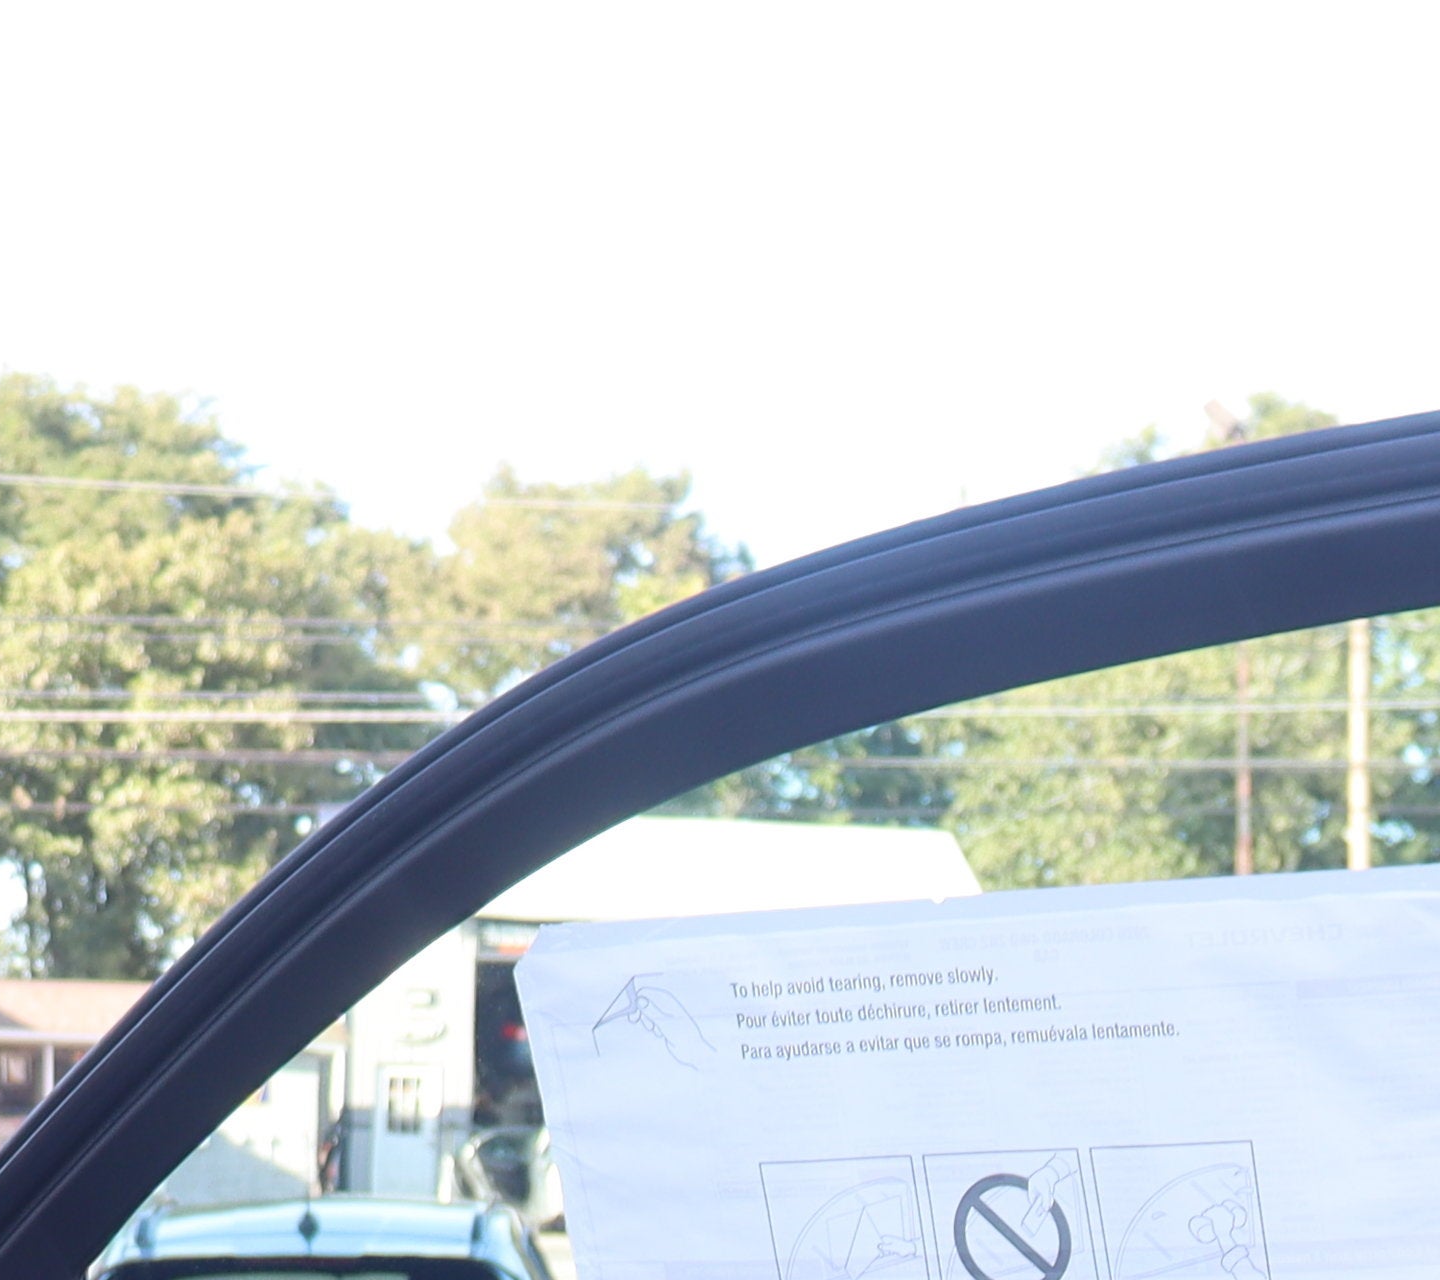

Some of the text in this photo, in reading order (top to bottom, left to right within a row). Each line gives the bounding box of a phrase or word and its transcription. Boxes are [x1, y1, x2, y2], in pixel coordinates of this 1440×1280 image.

[730, 965, 999, 1000] To help avoid tearing, remove slowly.
[736, 994, 1062, 1029] Pour éviter toute déchirure, retirer lentement.
[741, 1020, 1180, 1061] Para ayudarse a evitar que se rompa, remuévala lentamente.
